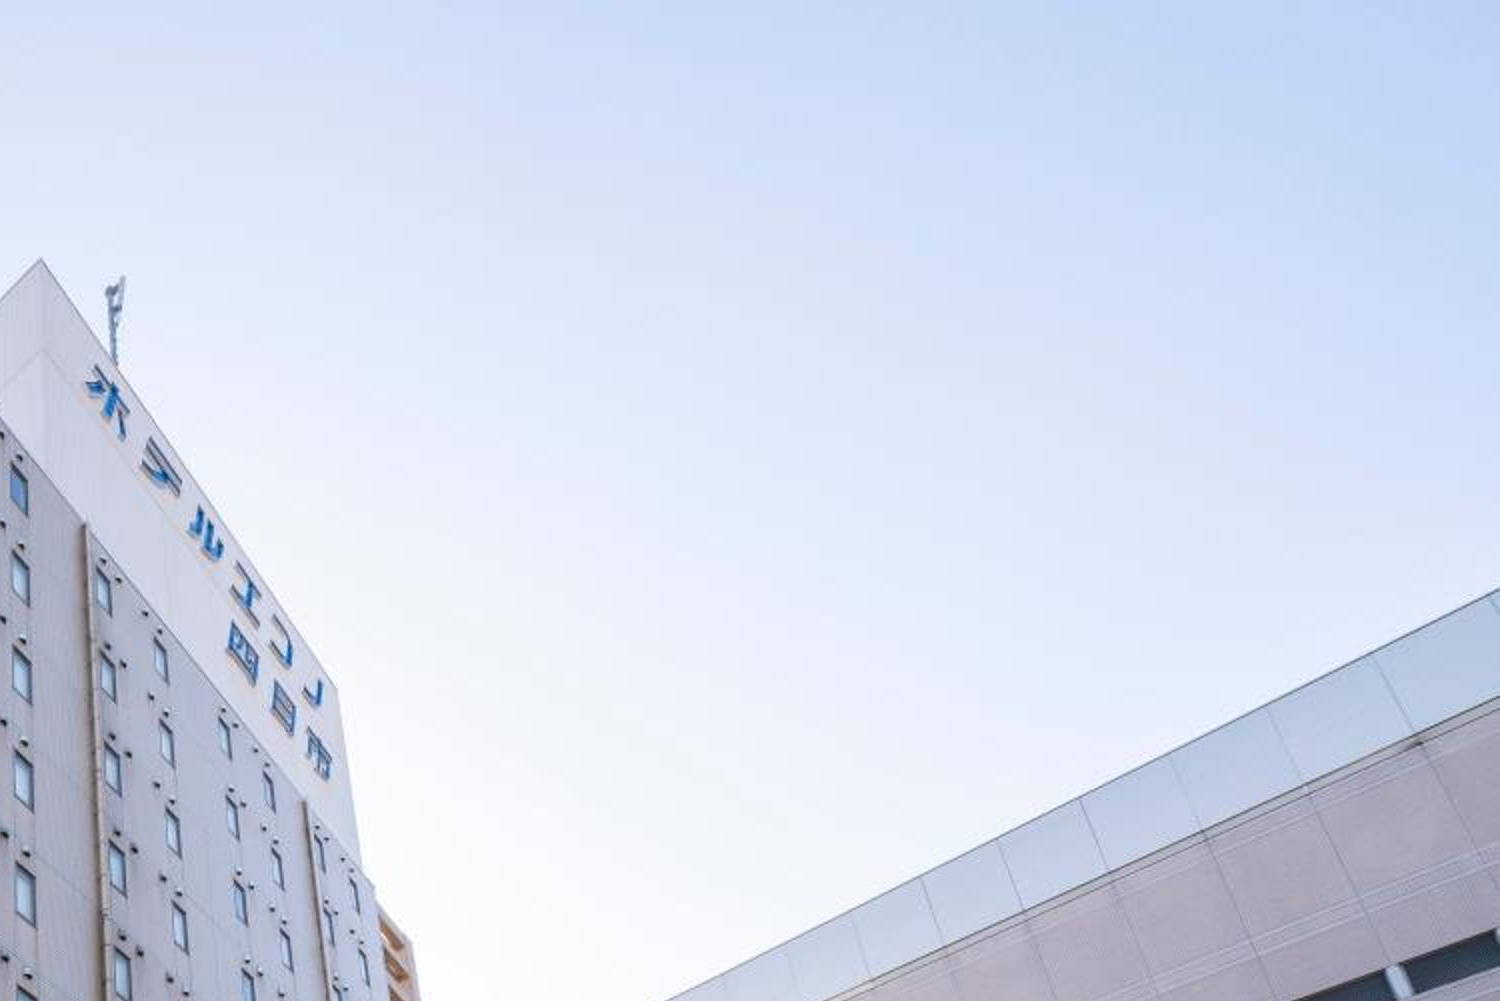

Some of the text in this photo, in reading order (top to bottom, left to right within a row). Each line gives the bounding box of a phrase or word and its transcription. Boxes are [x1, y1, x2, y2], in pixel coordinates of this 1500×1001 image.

[85, 364, 324, 706] ホテルエコノ
[227, 619, 333, 781] 四日市
